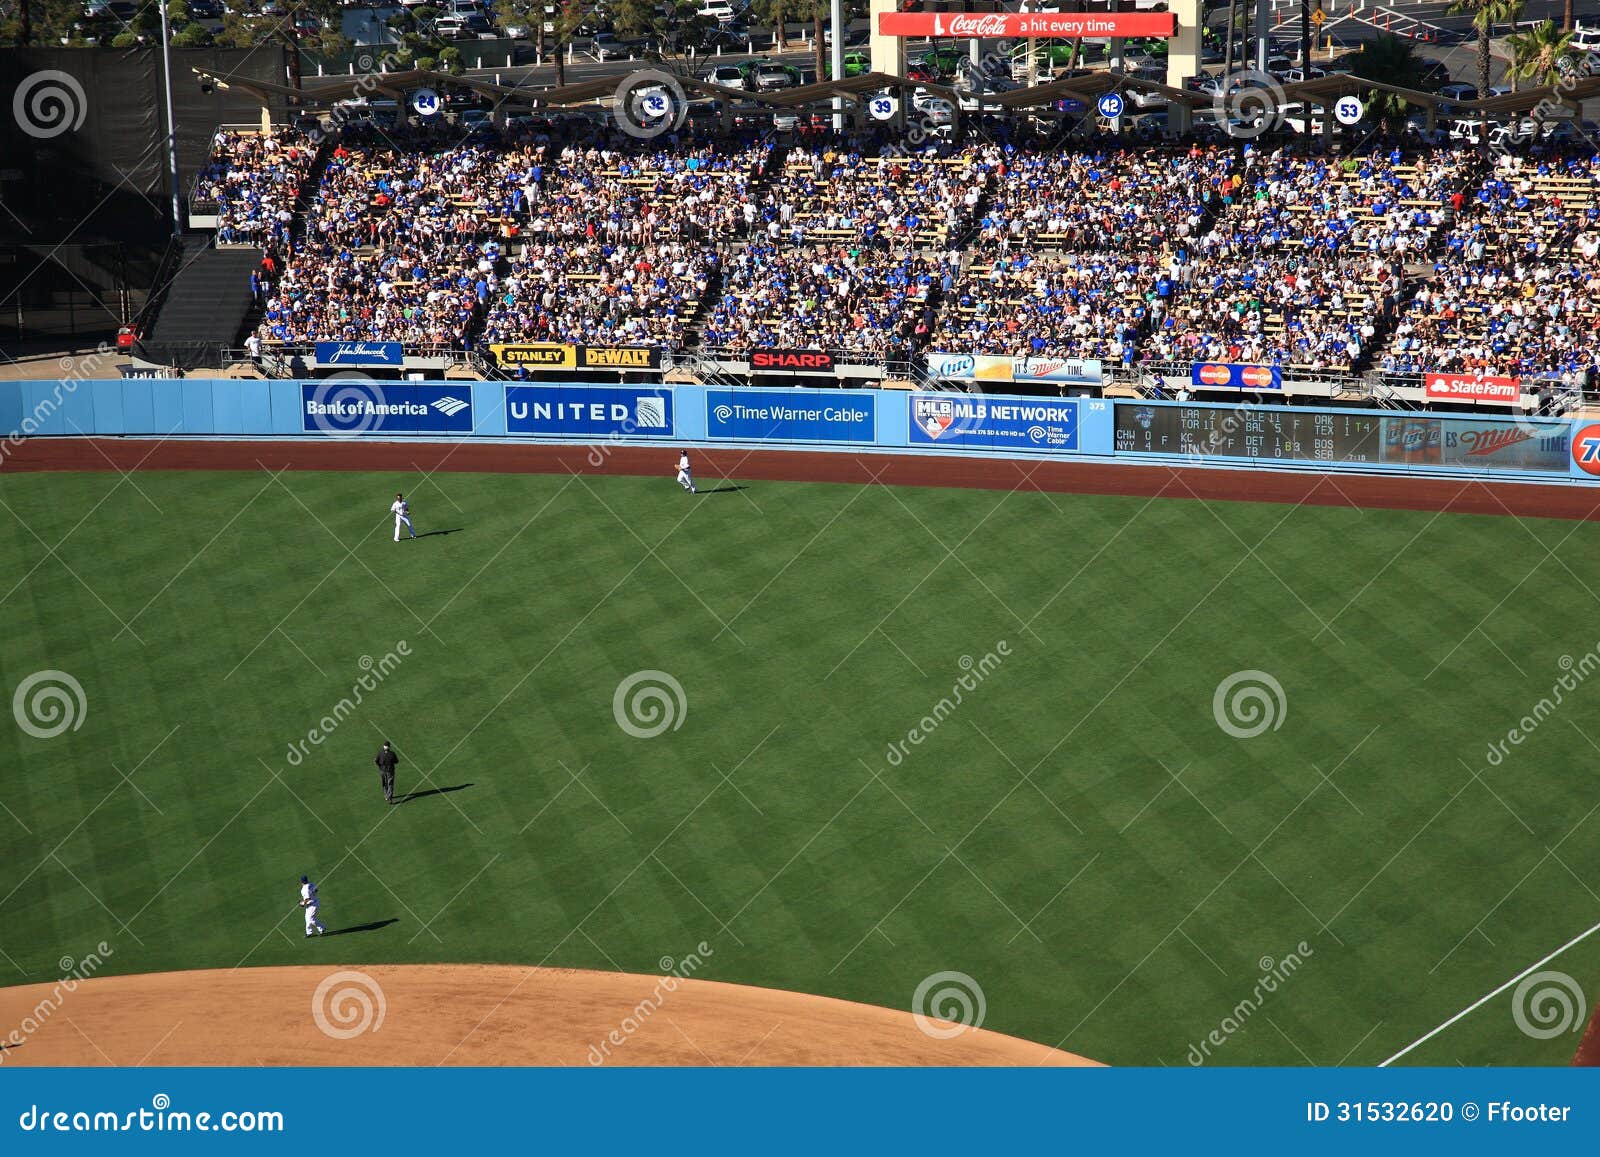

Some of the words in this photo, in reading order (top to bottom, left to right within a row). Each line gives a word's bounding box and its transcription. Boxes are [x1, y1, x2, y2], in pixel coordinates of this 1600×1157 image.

[950, 14, 1009, 35] Coca-Cola
[1020, 21, 1028, 32] a
[1031, 19, 1047, 32] hit
[1050, 21, 1084, 34] every
[1087, 19, 1116, 32] time
[418, 95, 436, 109] 24
[647, 97, 665, 110] 32
[874, 100, 892, 114] 39
[1101, 98, 1119, 113] 42
[1340, 104, 1358, 118] 53
[507, 350, 562, 363] STANLEY
[753, 353, 830, 367] SHARP
[1030, 361, 1066, 377] Miller
[1067, 364, 1083, 377] TIME
[306, 399, 346, 415] Bank
[348, 399, 364, 415] of
[366, 400, 428, 416] America
[510, 401, 629, 421] UNITED
[733, 404, 768, 420] Time
[770, 406, 822, 422] Warner
[917, 401, 951, 413] MLB
[955, 404, 987, 419] MLB
[1089, 402, 1105, 411] 375
[1181, 419, 1200, 430] TOR
[1204, 420, 1214, 431] 11
[1245, 421, 1265, 433] BAL
[1315, 425, 1334, 436] TEX
[1116, 430, 1136, 441] CHW
[1161, 436, 1168, 445] F
[1181, 432, 1193, 443] KC
[1245, 435, 1264, 446] DET
[1446, 431, 1458, 448] ES
[1540, 434, 1568, 452] TIME
[1116, 441, 1135, 451] NYY
[1314, 439, 1334, 450] BOS
[1246, 446, 1259, 457] TB
